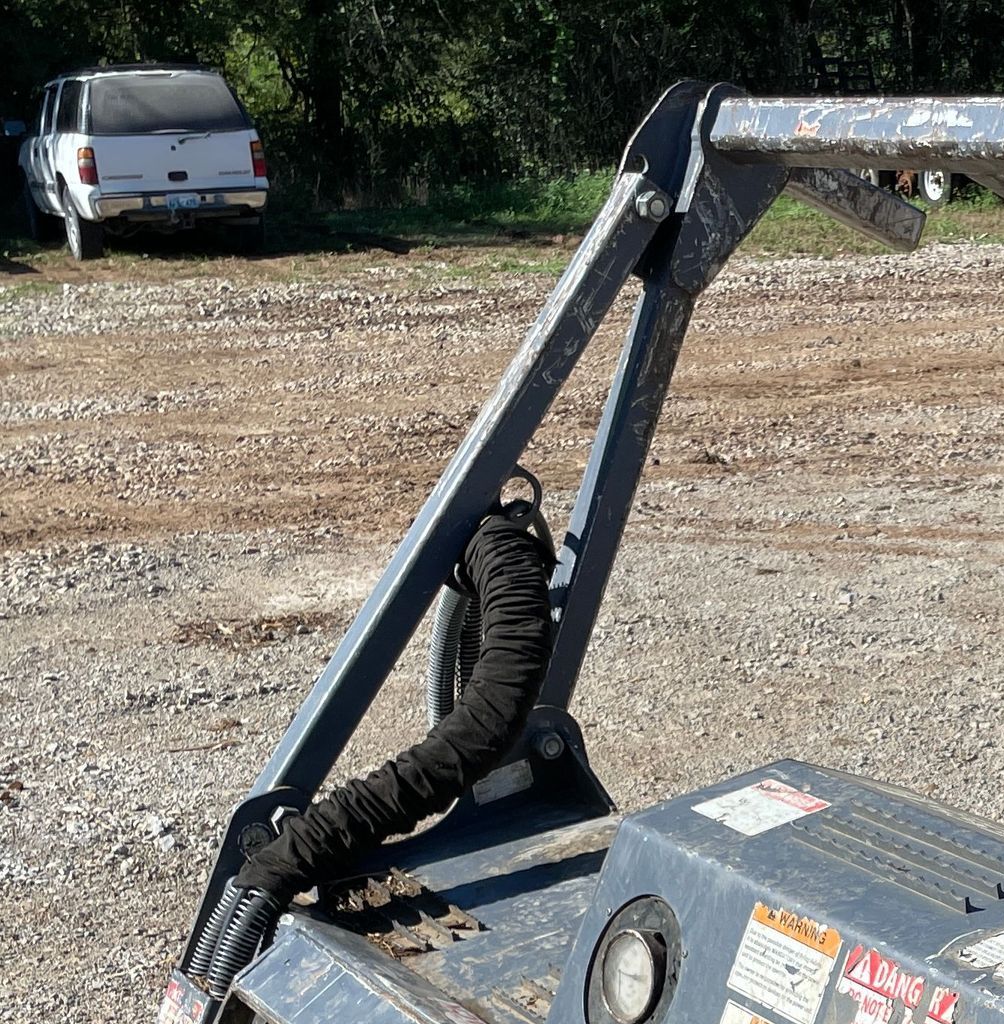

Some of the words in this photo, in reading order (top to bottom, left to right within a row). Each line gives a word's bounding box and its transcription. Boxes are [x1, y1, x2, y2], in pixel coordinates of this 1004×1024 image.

[779, 911, 827, 945] WARNING
[873, 956, 949, 1016] DANGR
[862, 995, 883, 1018] NOT
